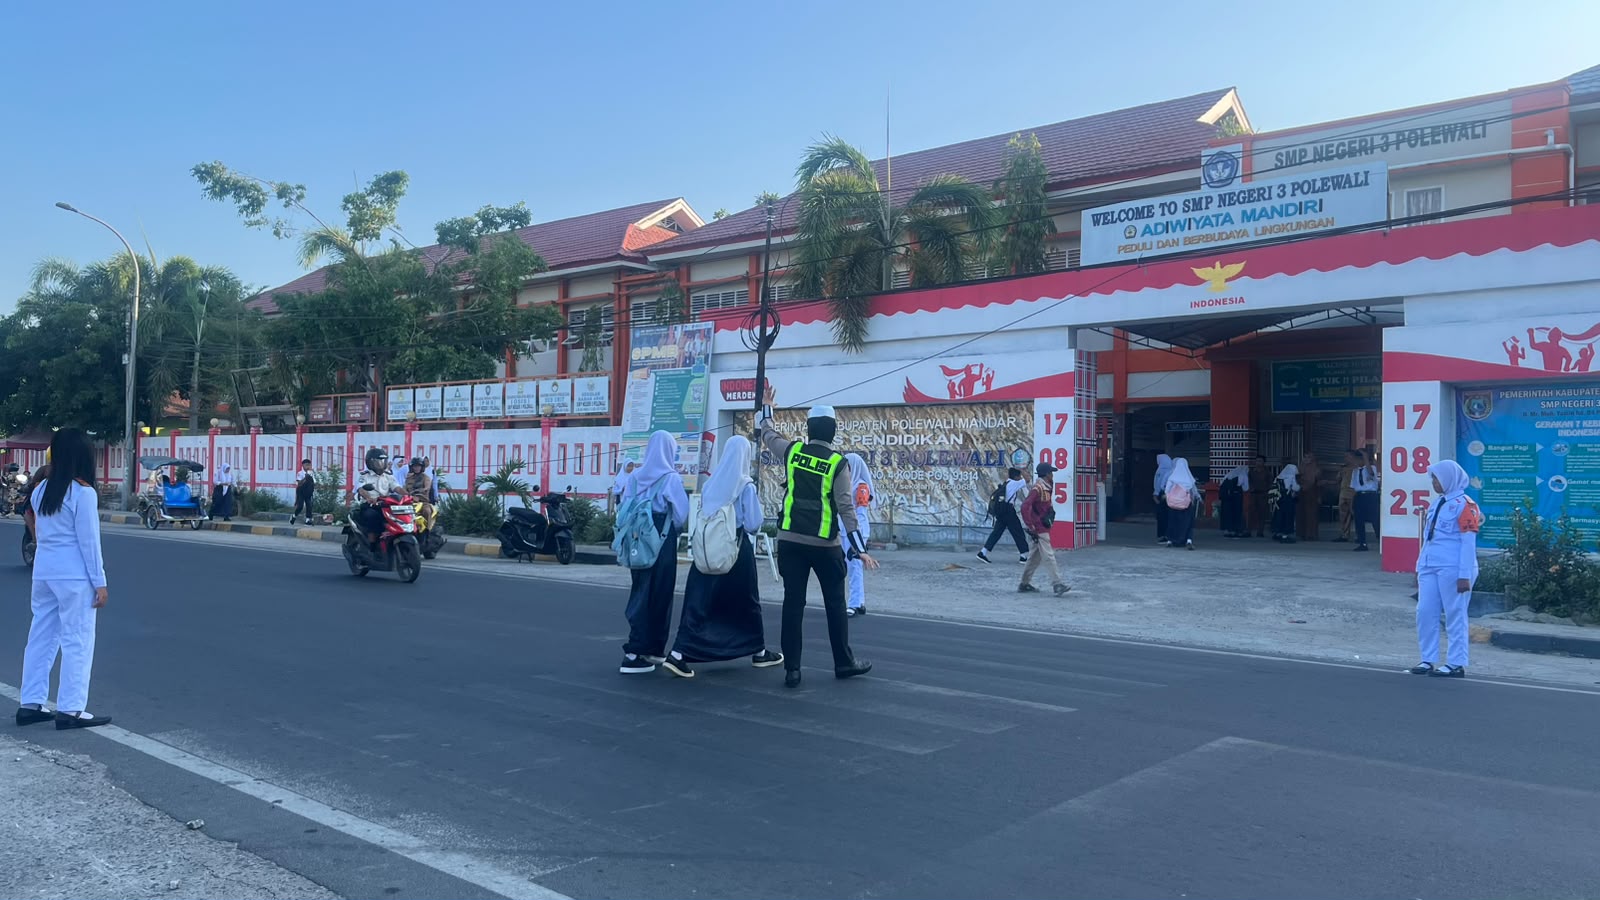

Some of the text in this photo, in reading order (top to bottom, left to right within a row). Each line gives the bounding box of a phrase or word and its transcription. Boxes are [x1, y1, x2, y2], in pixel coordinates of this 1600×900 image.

[1274, 120, 1487, 168] SMP NEGERI 3 POLEWALI
[1091, 170, 1370, 227] WELCOME TO SMP NEGERI 3 POLEWALI
[1140, 198, 1323, 237] ADIWIYATA MANDIRI
[1117, 217, 1335, 254] PEDULI DAN BERBUDAYA LINGKUNGAN
[1190, 296, 1246, 309] INDONESIA
[1352, 375, 1382, 384] PILA
[726, 391, 756, 400] MERDEK
[1500, 387, 1600, 398] PEMERINTAH KABUPATE
[1562, 400, 1593, 408] NEGERI
[891, 418, 954, 430] POLEWALI
[958, 416, 1017, 428] MANDAR
[1044, 413, 1068, 435] 17
[1394, 404, 1431, 429] 17
[1535, 421, 1574, 429] GERAKAN
[851, 433, 964, 446] PENDIDIKAN
[791, 453, 832, 475] POLISI
[880, 451, 893, 467] 3
[896, 449, 1007, 468] POLEWALI
[1040, 448, 1068, 469] 08
[1390, 446, 1431, 474] 08
[897, 470, 924, 480] KODE
[928, 470, 949, 480] POS
[876, 493, 931, 506] WALI
[1390, 489, 1430, 516] 25
